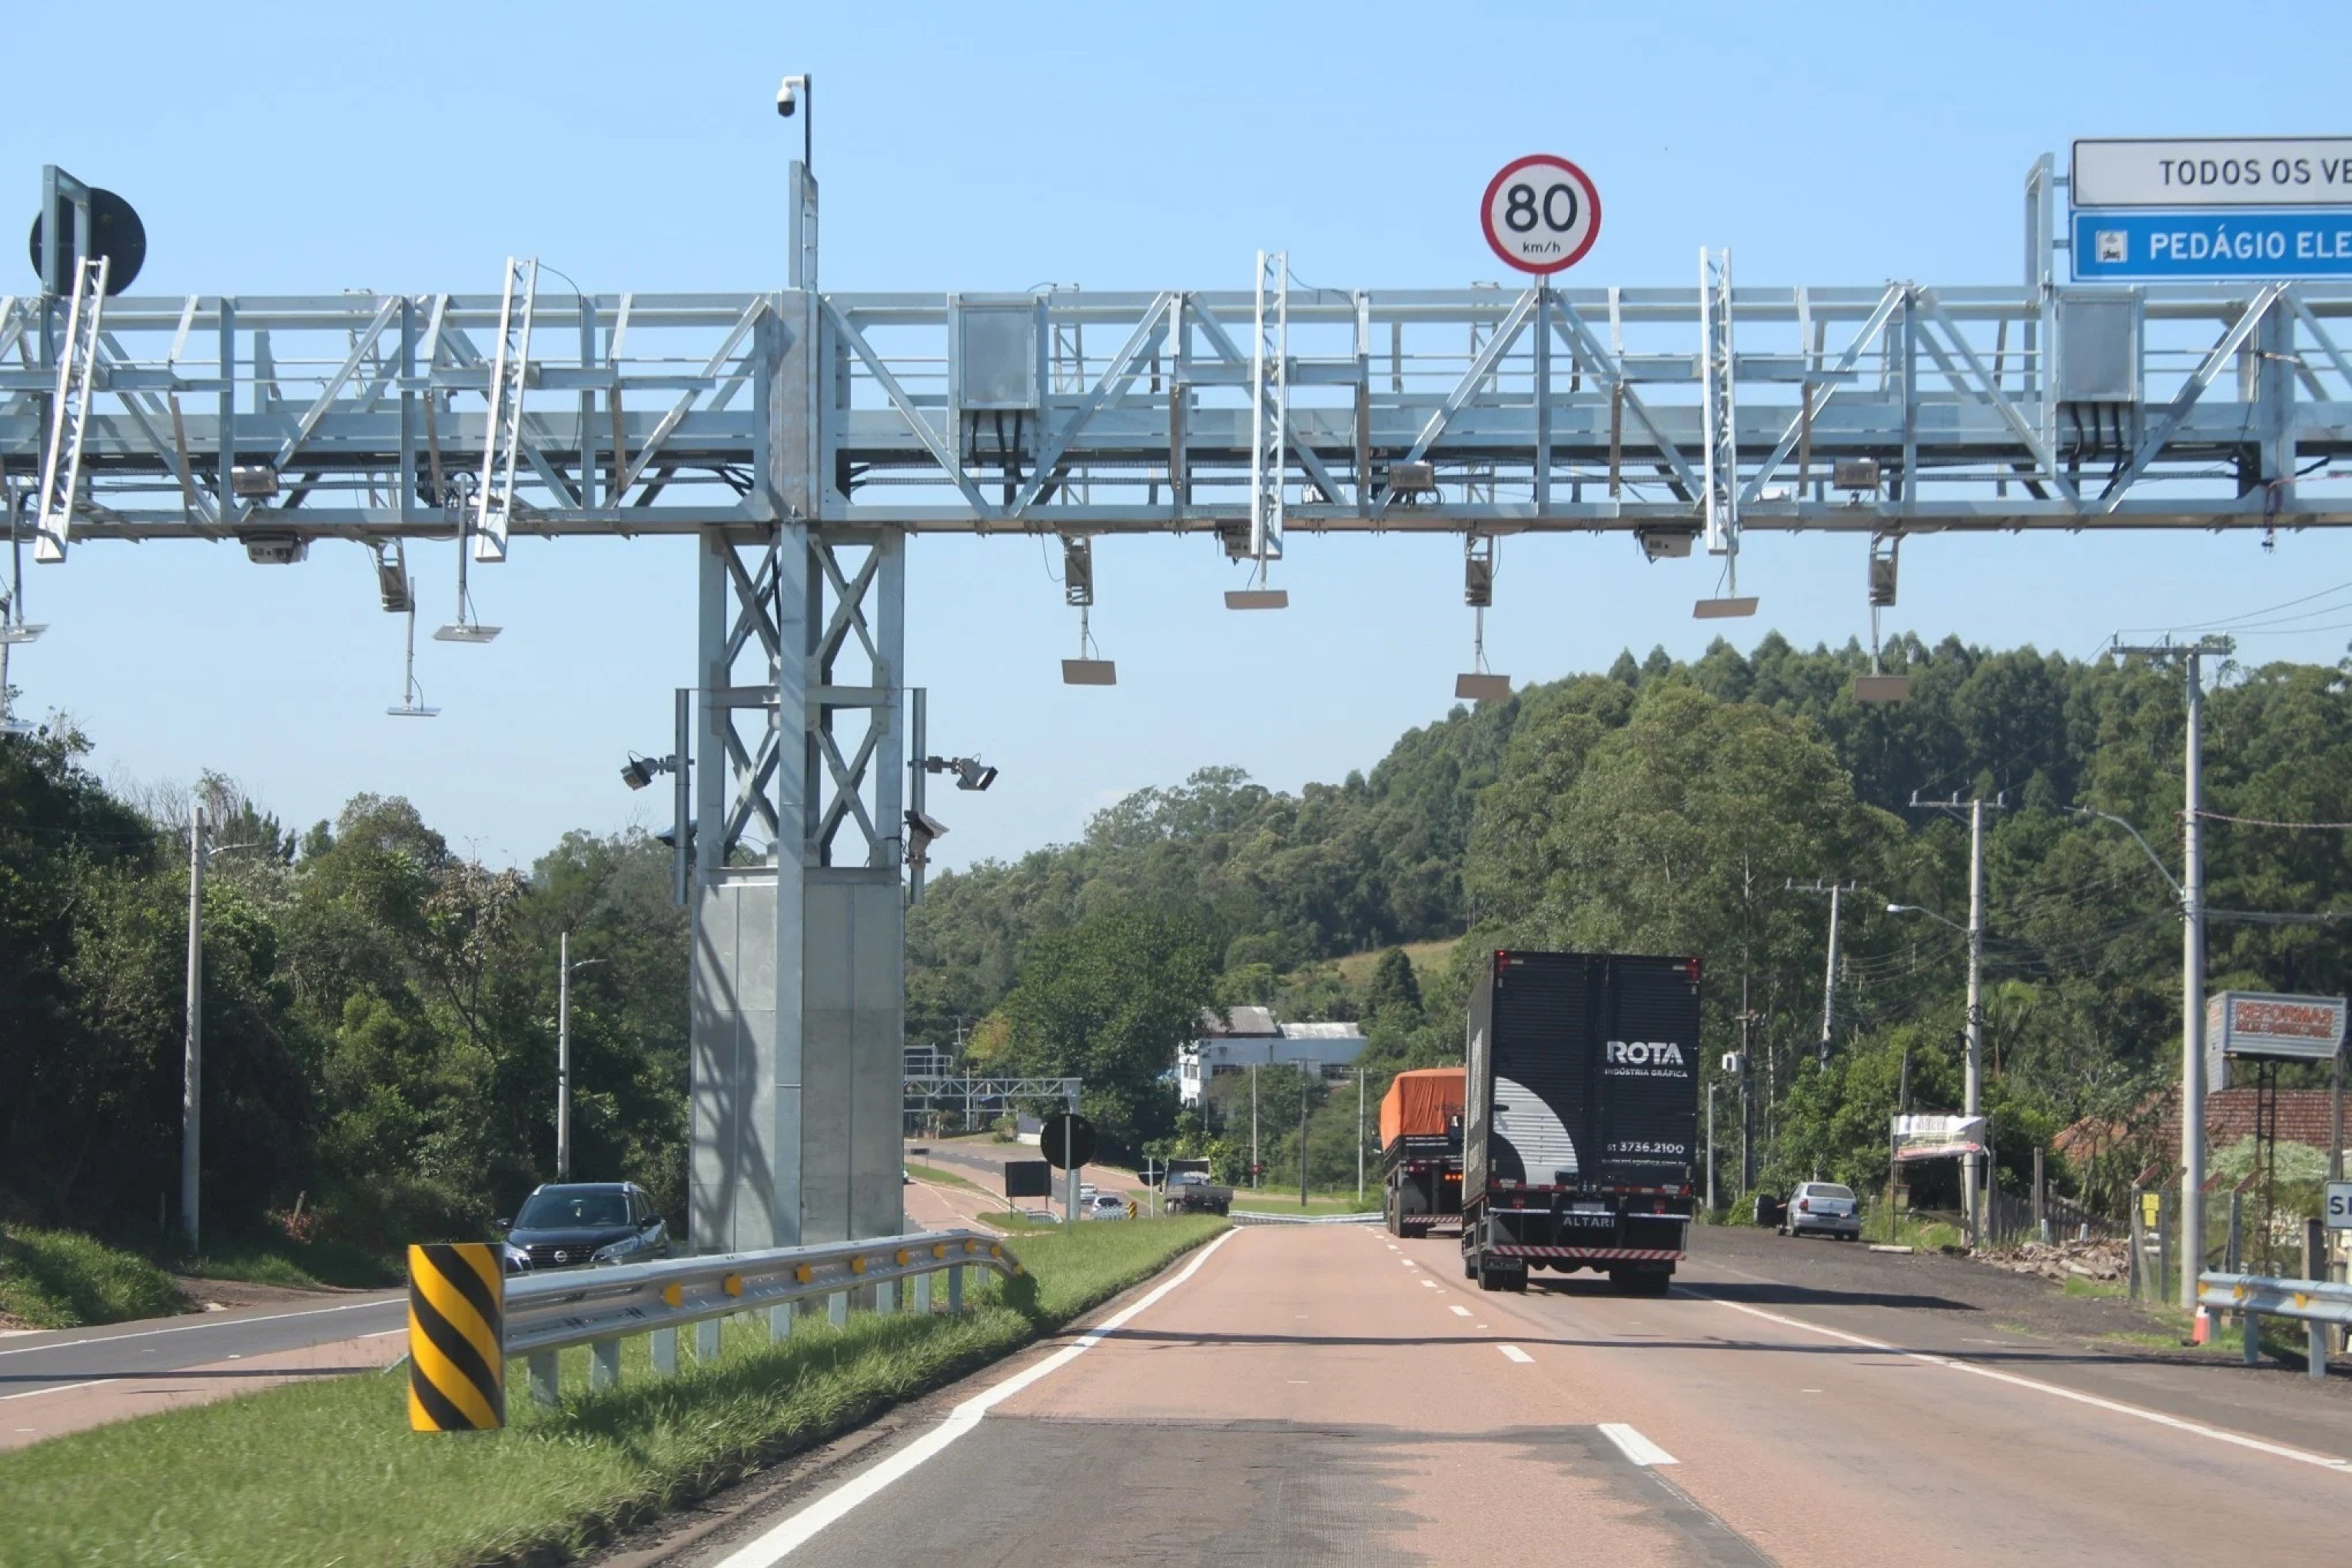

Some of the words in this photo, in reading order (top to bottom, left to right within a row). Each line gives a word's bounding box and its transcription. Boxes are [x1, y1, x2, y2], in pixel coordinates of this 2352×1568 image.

[2160, 158, 2261, 185] TODOS
[2272, 158, 2310, 184] OS
[1505, 183, 1577, 233] 80
[1523, 241, 1561, 254] km/h
[2151, 224, 2286, 260] PEDÁGIO
[2296, 231, 2352, 259] ELE
[2236, 1001, 2334, 1025] REFORMAS
[1606, 1041, 1684, 1065] ROTA
[1650, 1068, 1689, 1078] GRÁFICA
[1620, 1141, 1685, 1154] 3736.2100
[1563, 1217, 1615, 1227] ALTARI
